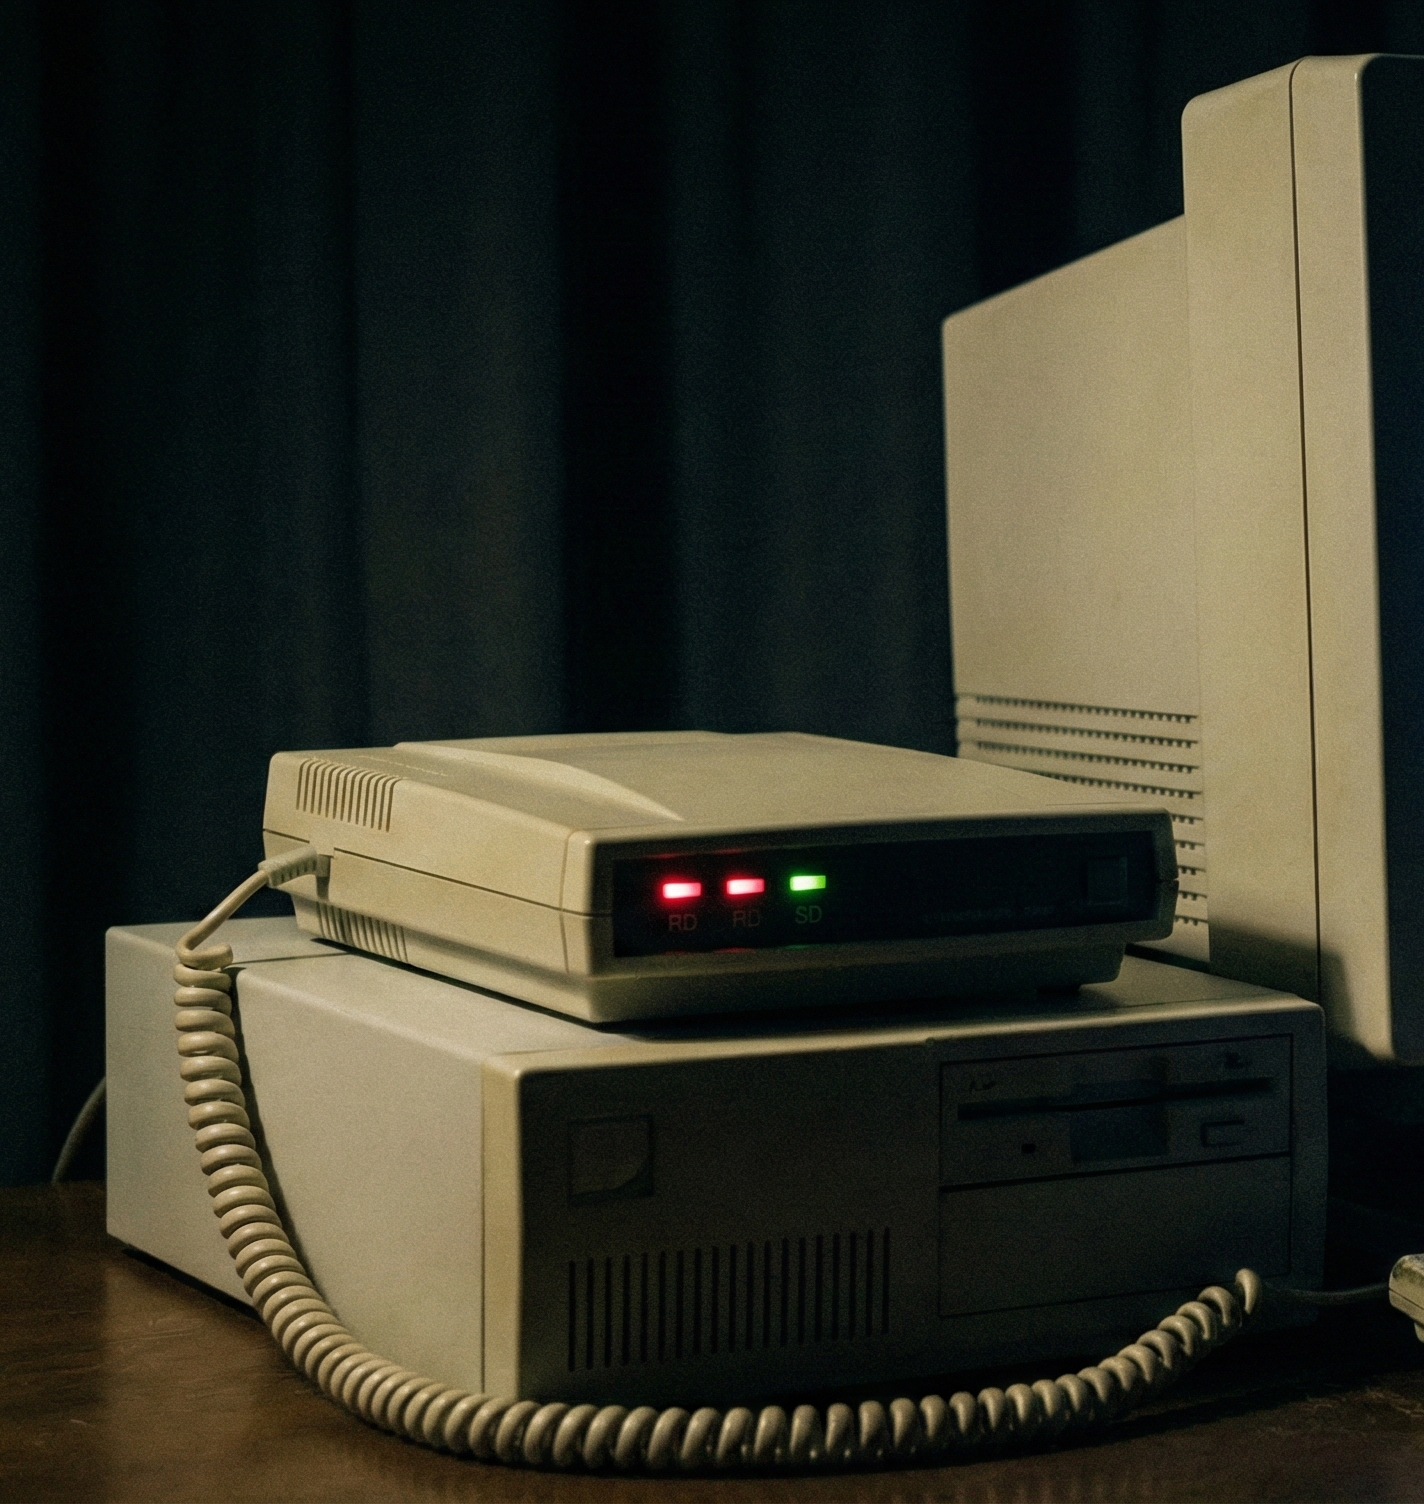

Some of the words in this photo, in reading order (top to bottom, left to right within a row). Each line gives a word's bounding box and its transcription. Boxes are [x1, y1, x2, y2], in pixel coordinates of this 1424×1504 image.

[667, 913, 698, 932] RD
[732, 909, 761, 929] RD
[794, 905, 823, 925] SD
